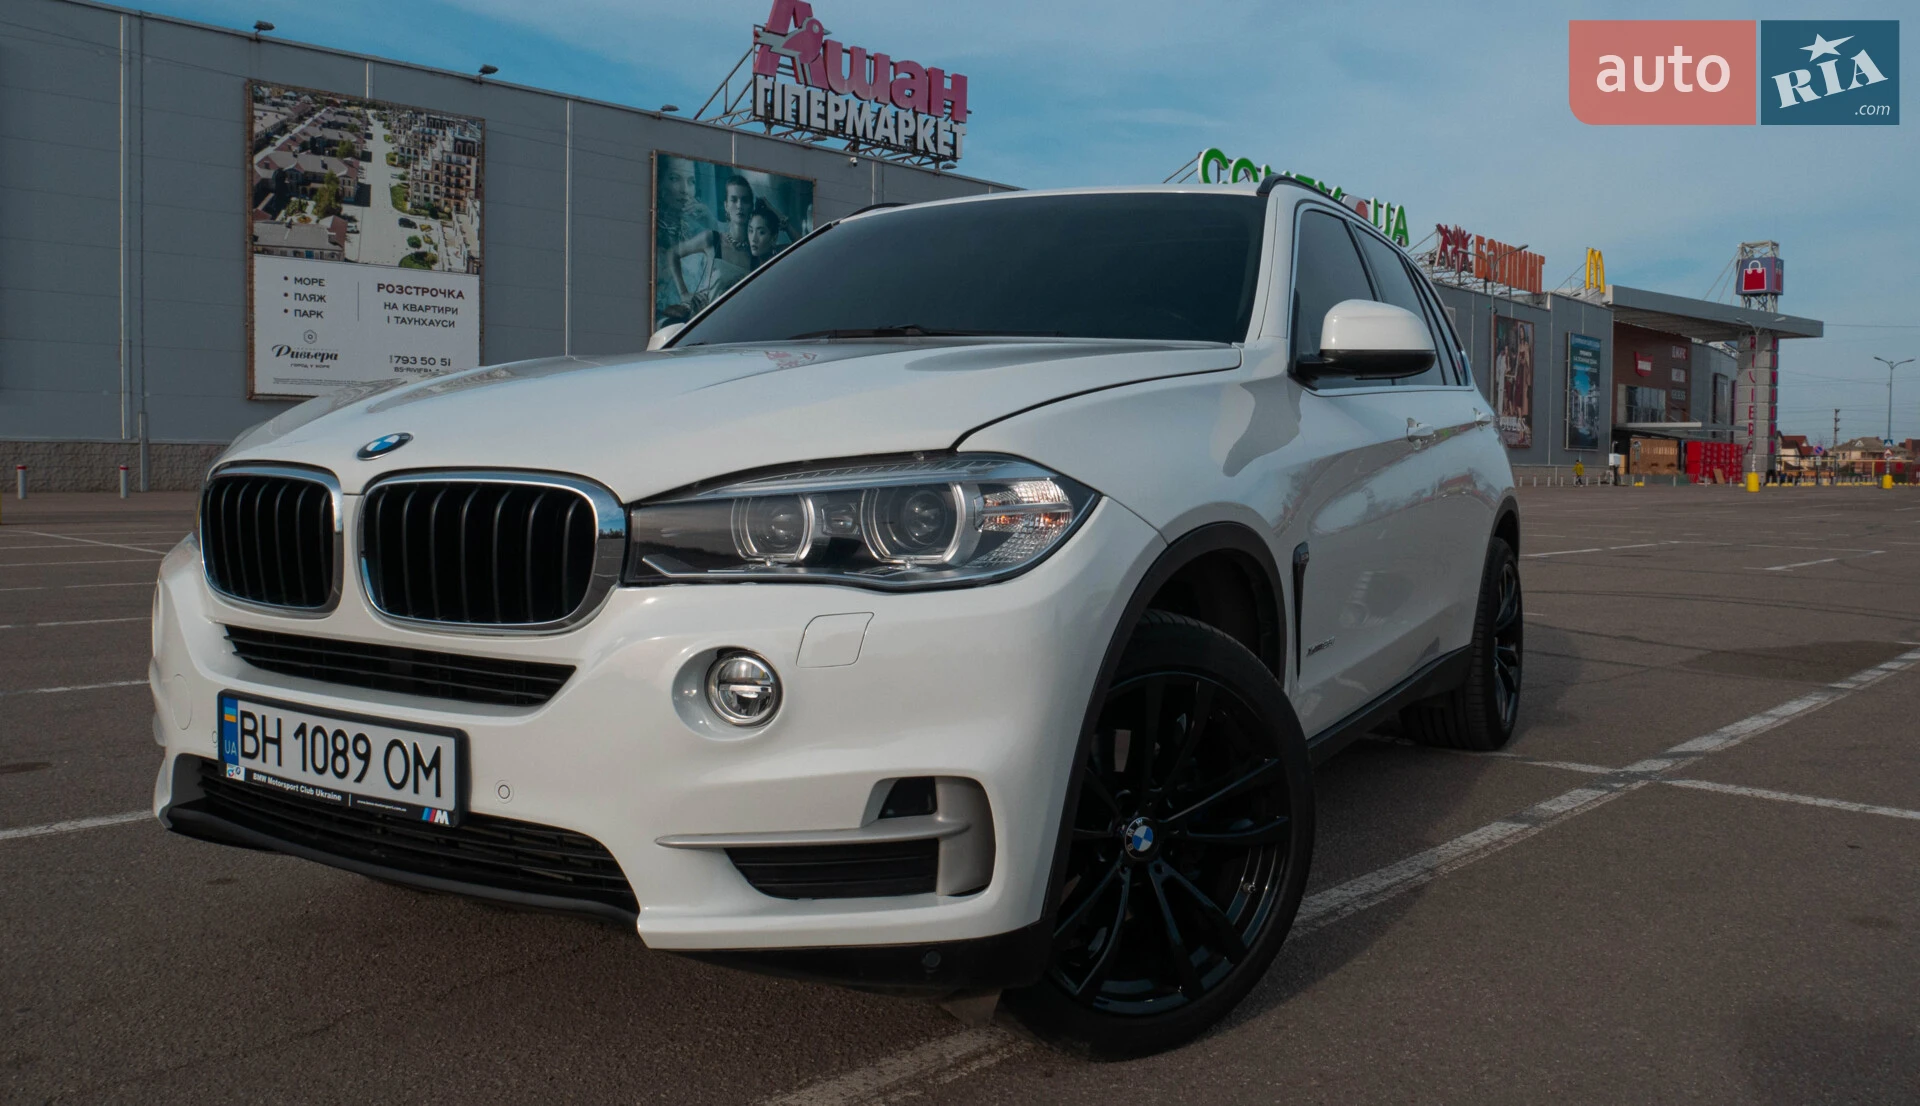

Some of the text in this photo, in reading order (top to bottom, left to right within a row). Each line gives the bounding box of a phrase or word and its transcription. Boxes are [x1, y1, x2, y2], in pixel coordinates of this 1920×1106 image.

[753, 76, 966, 160] ГІПЕРМАРКЕТ
[294, 276, 326, 287] МОРЕ
[294, 292, 327, 304] ПЛЯЖ
[376, 282, 465, 300] РОЗСТРОЧКА
[294, 308, 324, 319] ПАРК
[383, 301, 459, 315] НА КВАРТИРИ
[393, 315, 456, 328] ТАУНХАУСИ
[271, 344, 339, 363] Ривьера
[394, 355, 418, 366] 793
[420, 356, 437, 366] 50
[224, 739, 238, 757] UA
[239, 709, 442, 798] BH 1089 OM
[252, 772, 342, 802] BMW Motorsport Club Ukraine
[433, 809, 450, 826] M
